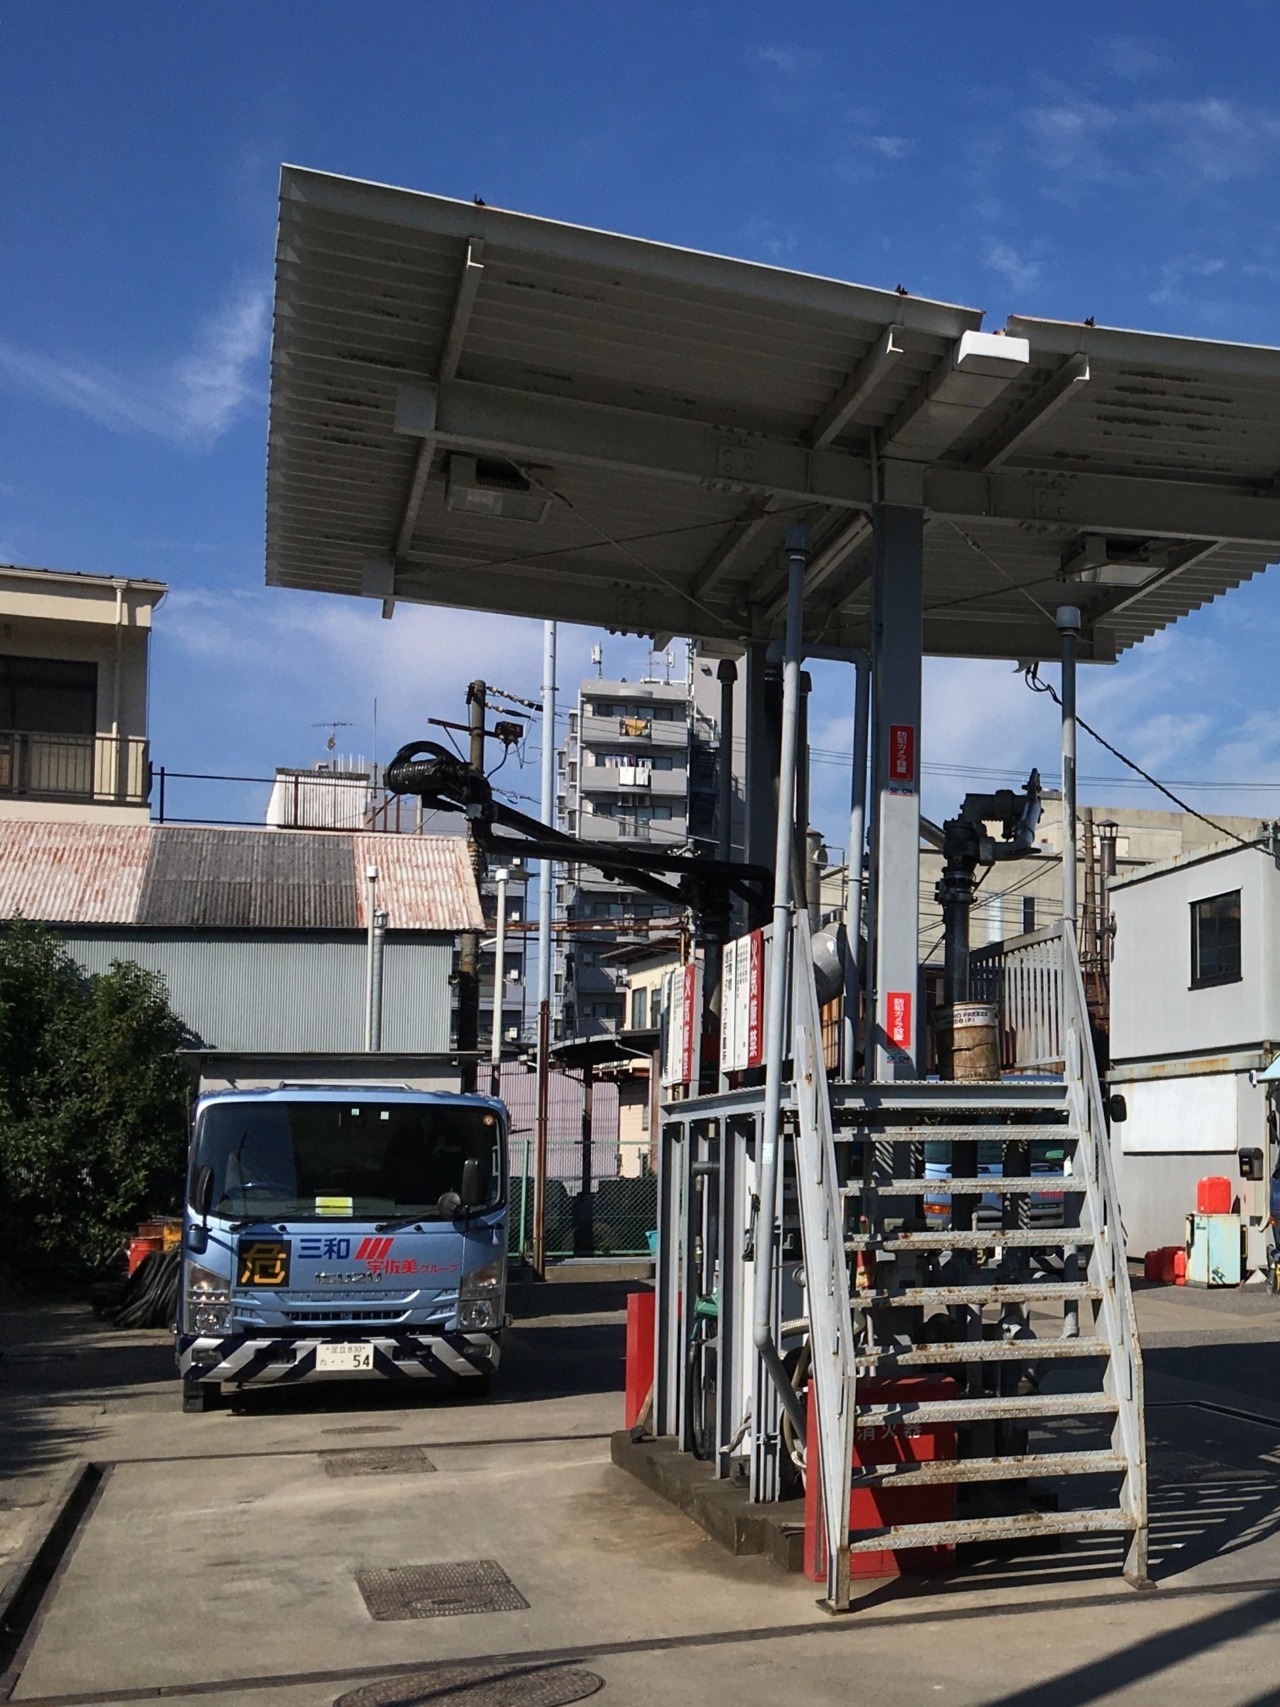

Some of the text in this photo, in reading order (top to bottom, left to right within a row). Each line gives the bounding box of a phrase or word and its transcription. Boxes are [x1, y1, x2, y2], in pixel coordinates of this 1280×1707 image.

[749, 939, 759, 1058] 火気厳禁
[241, 1243, 287, 1284] 危
[298, 1237, 350, 1260] 三和
[856, 1424, 922, 1440] 消火器
